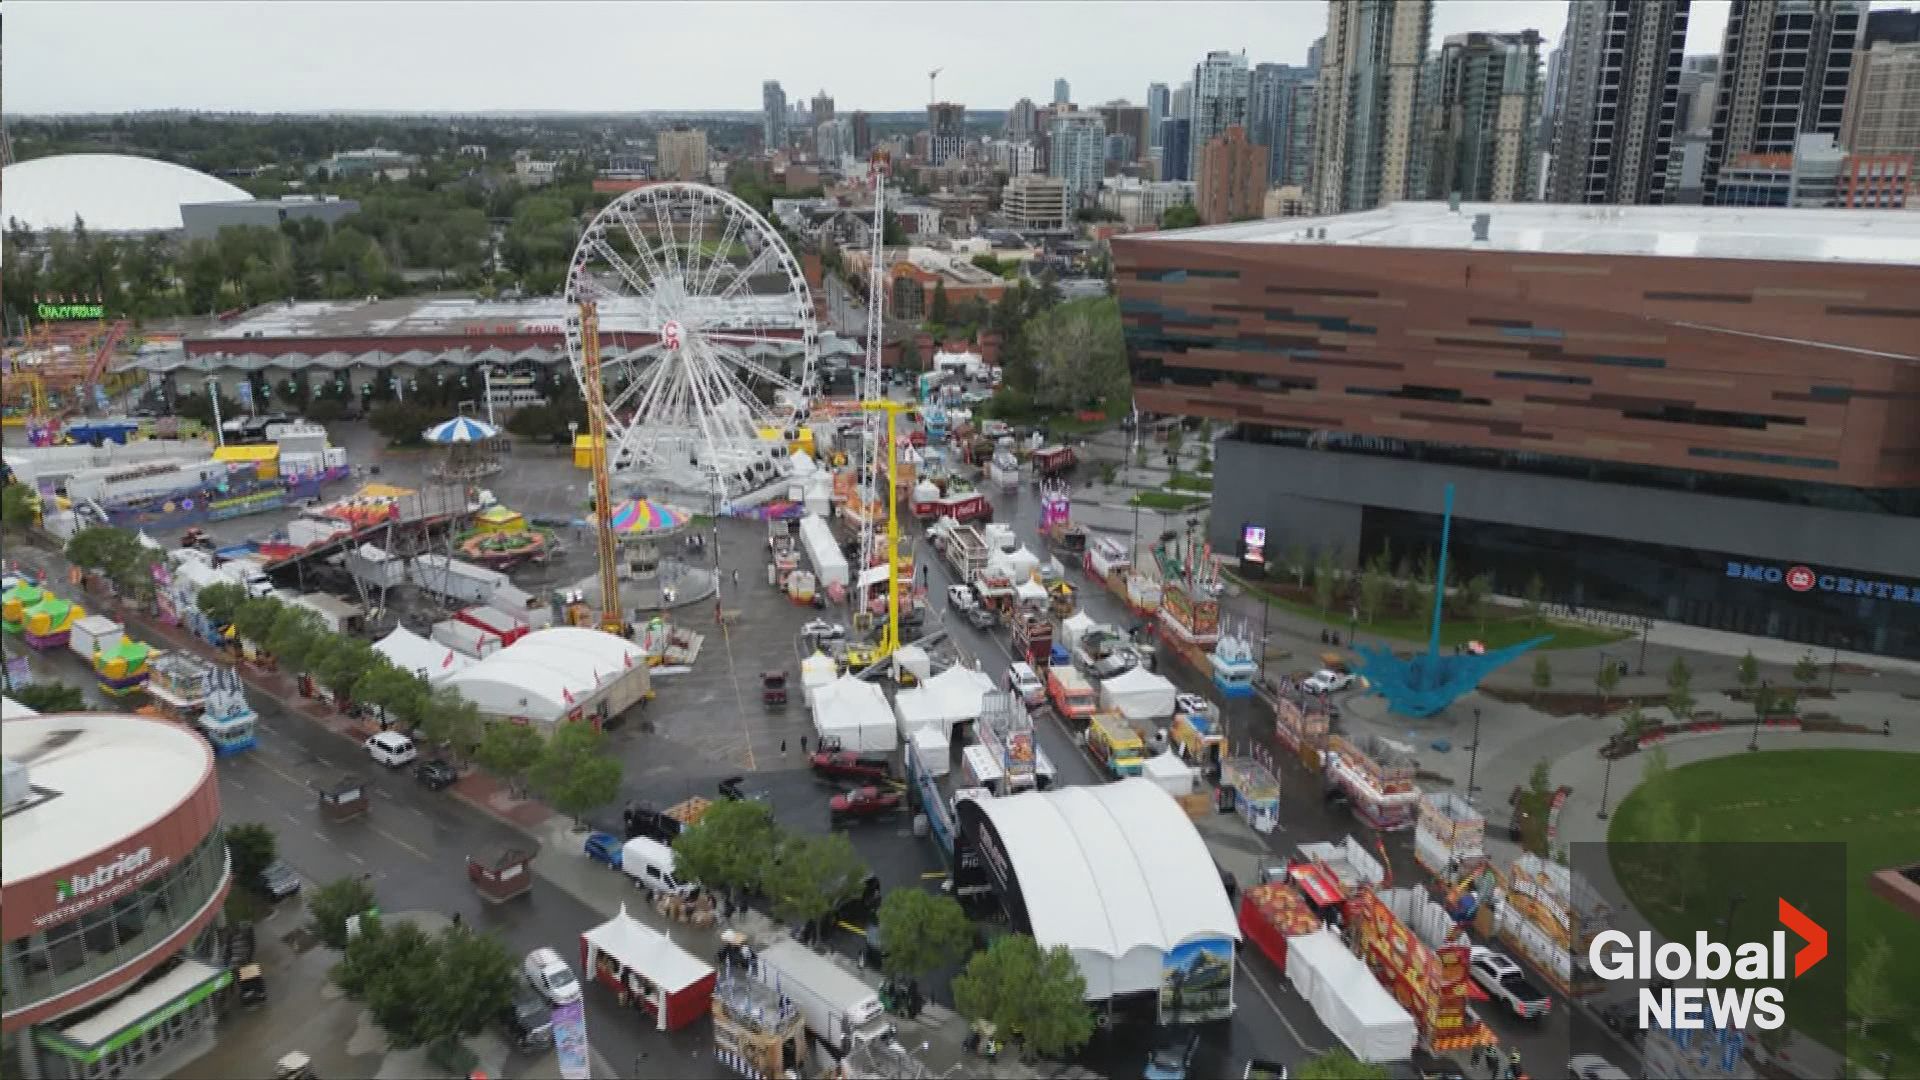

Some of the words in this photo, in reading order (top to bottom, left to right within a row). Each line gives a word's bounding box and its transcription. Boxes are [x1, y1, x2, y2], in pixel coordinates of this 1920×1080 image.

[1726, 562, 1783, 583] BMO
[32, 897, 96, 927] WESTERN
[97, 879, 134, 903] EVENT
